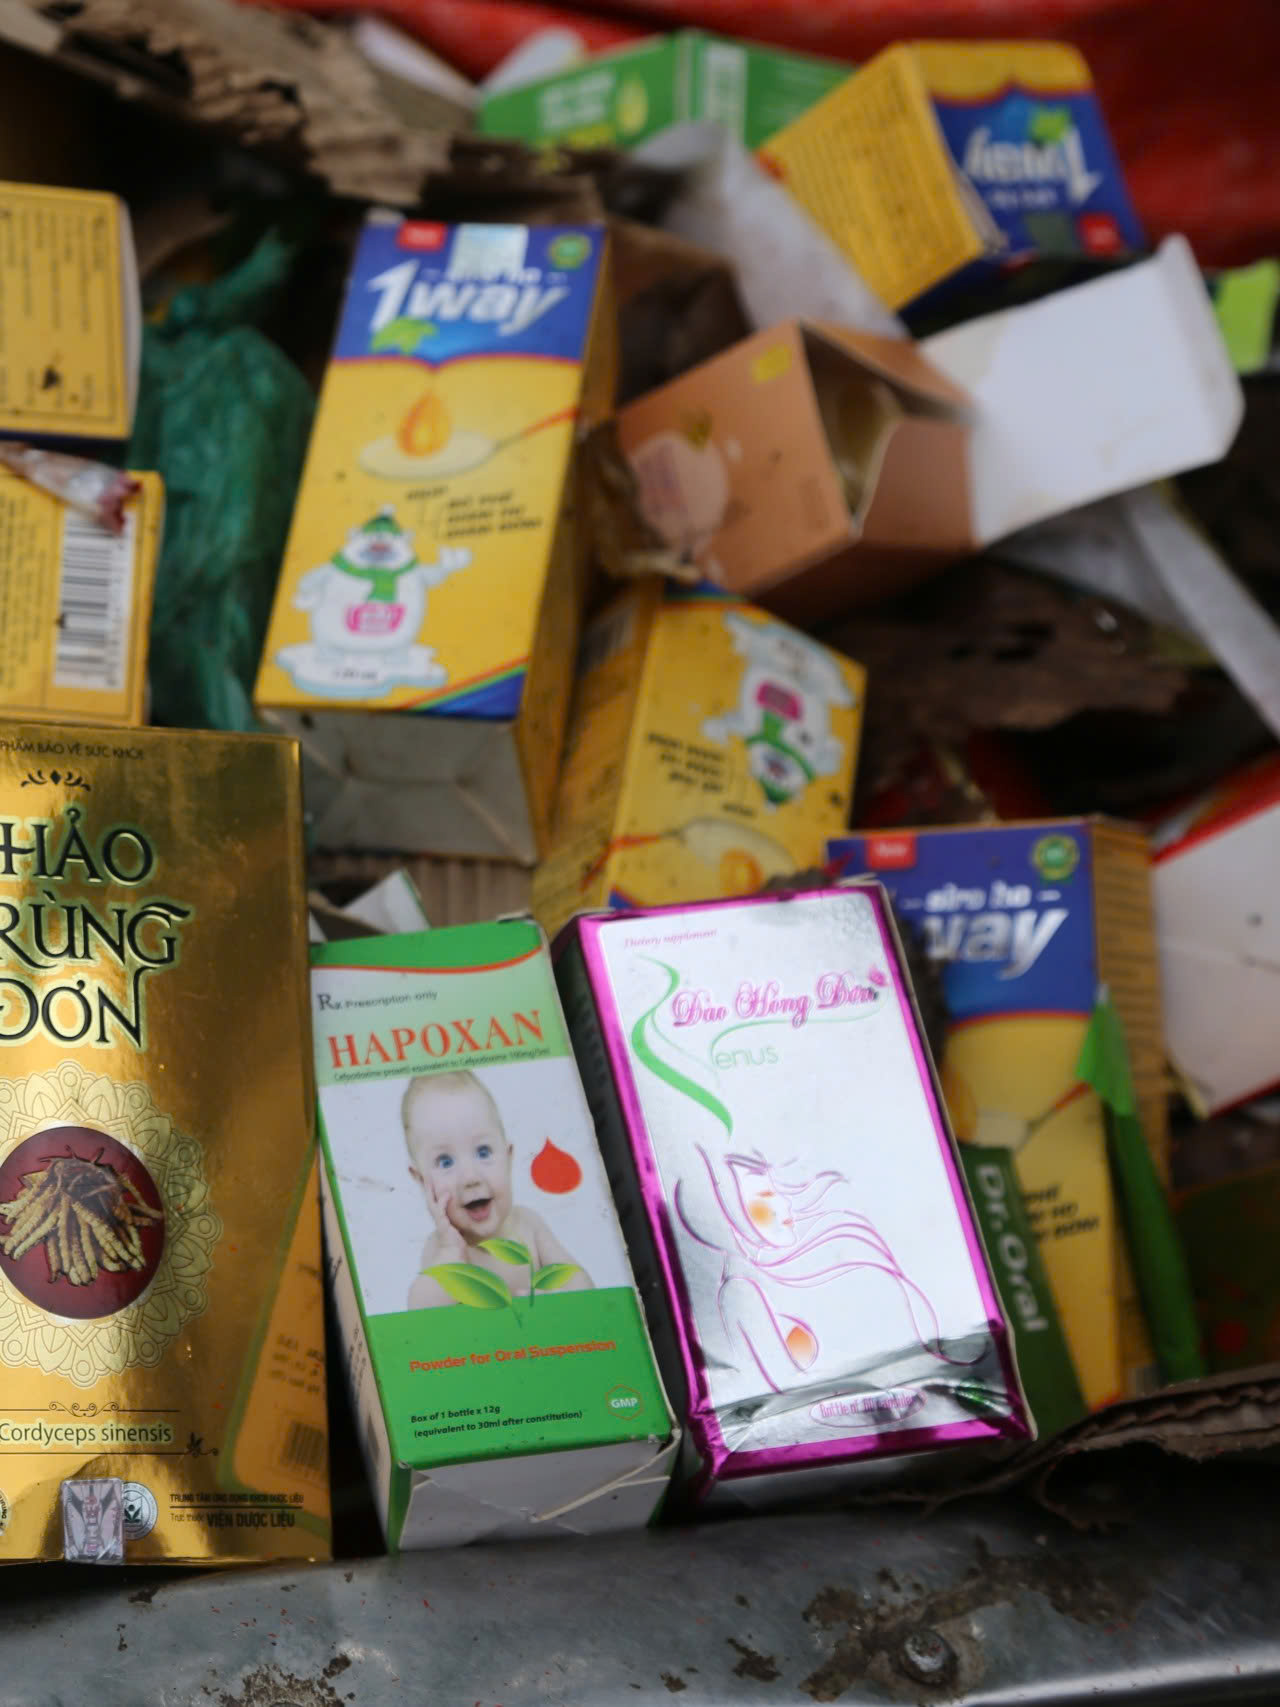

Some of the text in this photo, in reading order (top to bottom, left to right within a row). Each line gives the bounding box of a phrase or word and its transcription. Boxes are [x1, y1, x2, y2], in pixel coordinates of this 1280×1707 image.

[345, 994, 411, 1009] Prescription
[414, 990, 438, 1002] only
[327, 1009, 544, 1069] HAPOXAN
[409, 1339, 617, 1373] Powder for Oral Suspension
[611, 1397, 638, 1409] GMP
[411, 1414, 427, 1424] Box
[430, 1412, 439, 1421] of
[448, 1408, 475, 1418] bottle
[483, 1405, 501, 1416] 12g
[414, 1410, 583, 1438] (equivalent to 30ml after constitution)
[101, 1423, 172, 1443] sinensis
